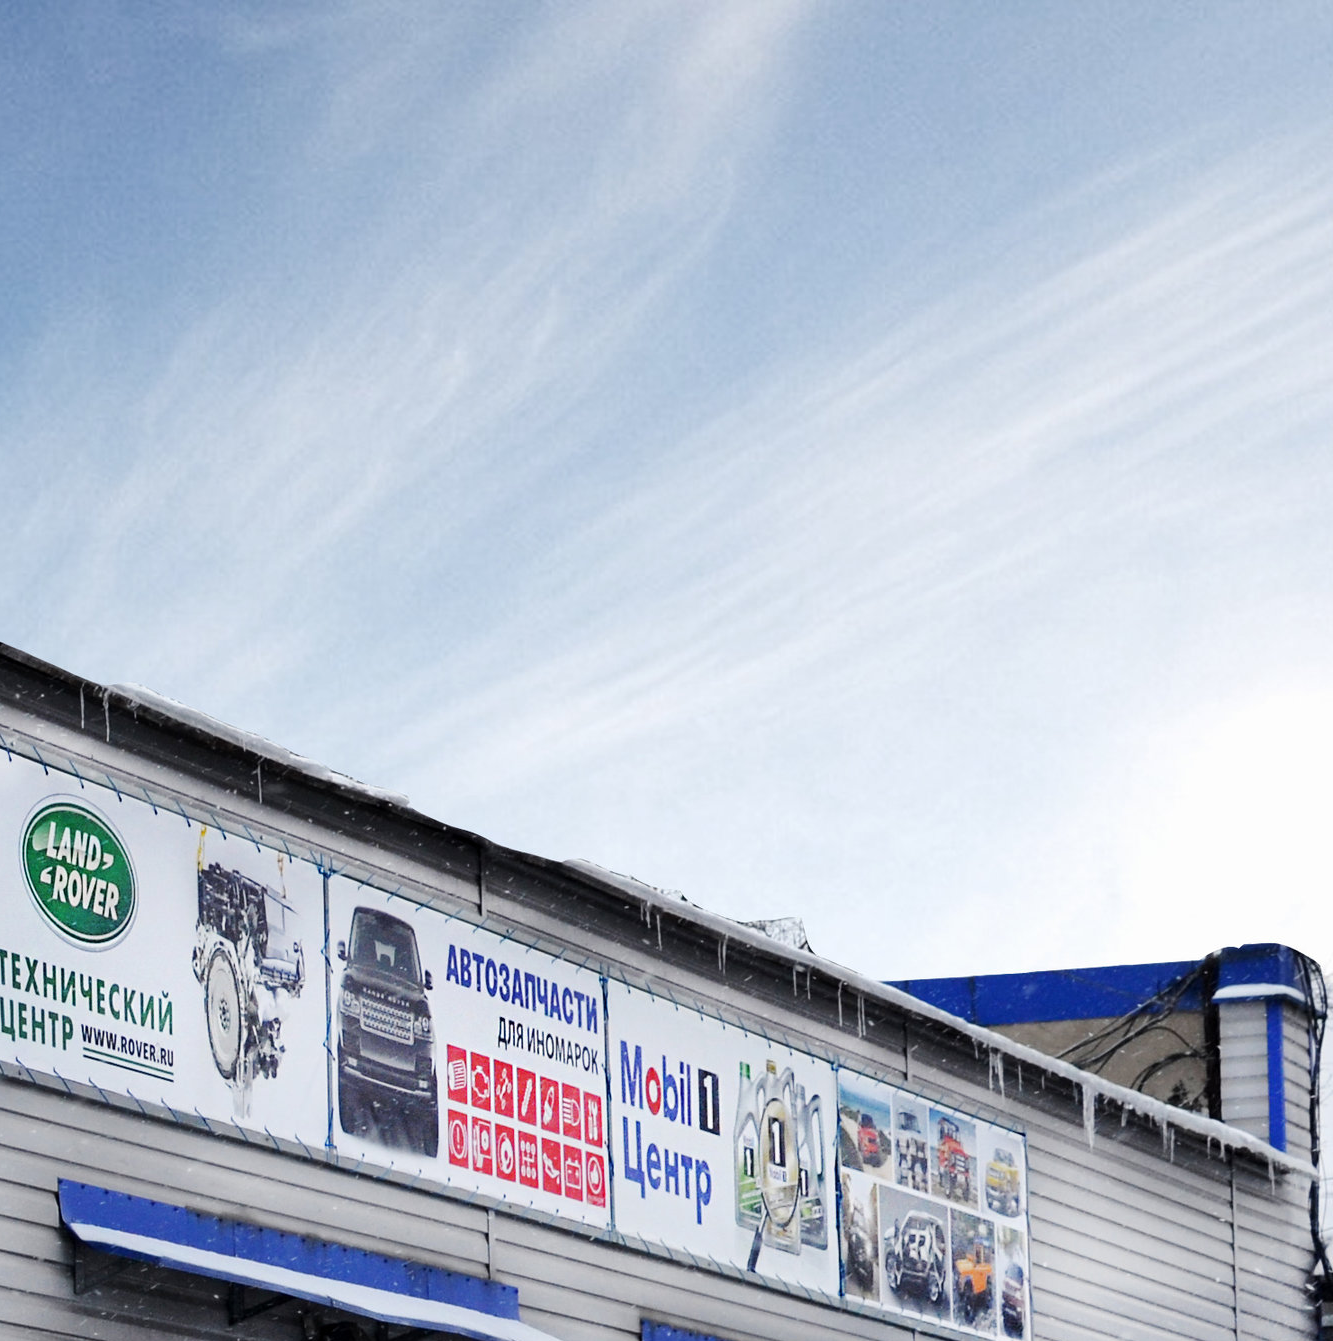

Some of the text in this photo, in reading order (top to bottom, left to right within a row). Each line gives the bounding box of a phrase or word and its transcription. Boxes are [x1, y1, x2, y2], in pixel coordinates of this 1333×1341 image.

[46, 821, 101, 871] LAND
[53, 865, 120, 920] ROVER
[446, 944, 598, 1034] АВТОЗАПЧАСТИ
[0, 996, 74, 1051] ЦЕНТР
[81, 1024, 174, 1067] WWW.ROVER.RU
[498, 1017, 598, 1075] ДЛЯ ИНОМАРОК
[620, 1040, 718, 1133] Mobil 1
[622, 1116, 712, 1225] Центр
